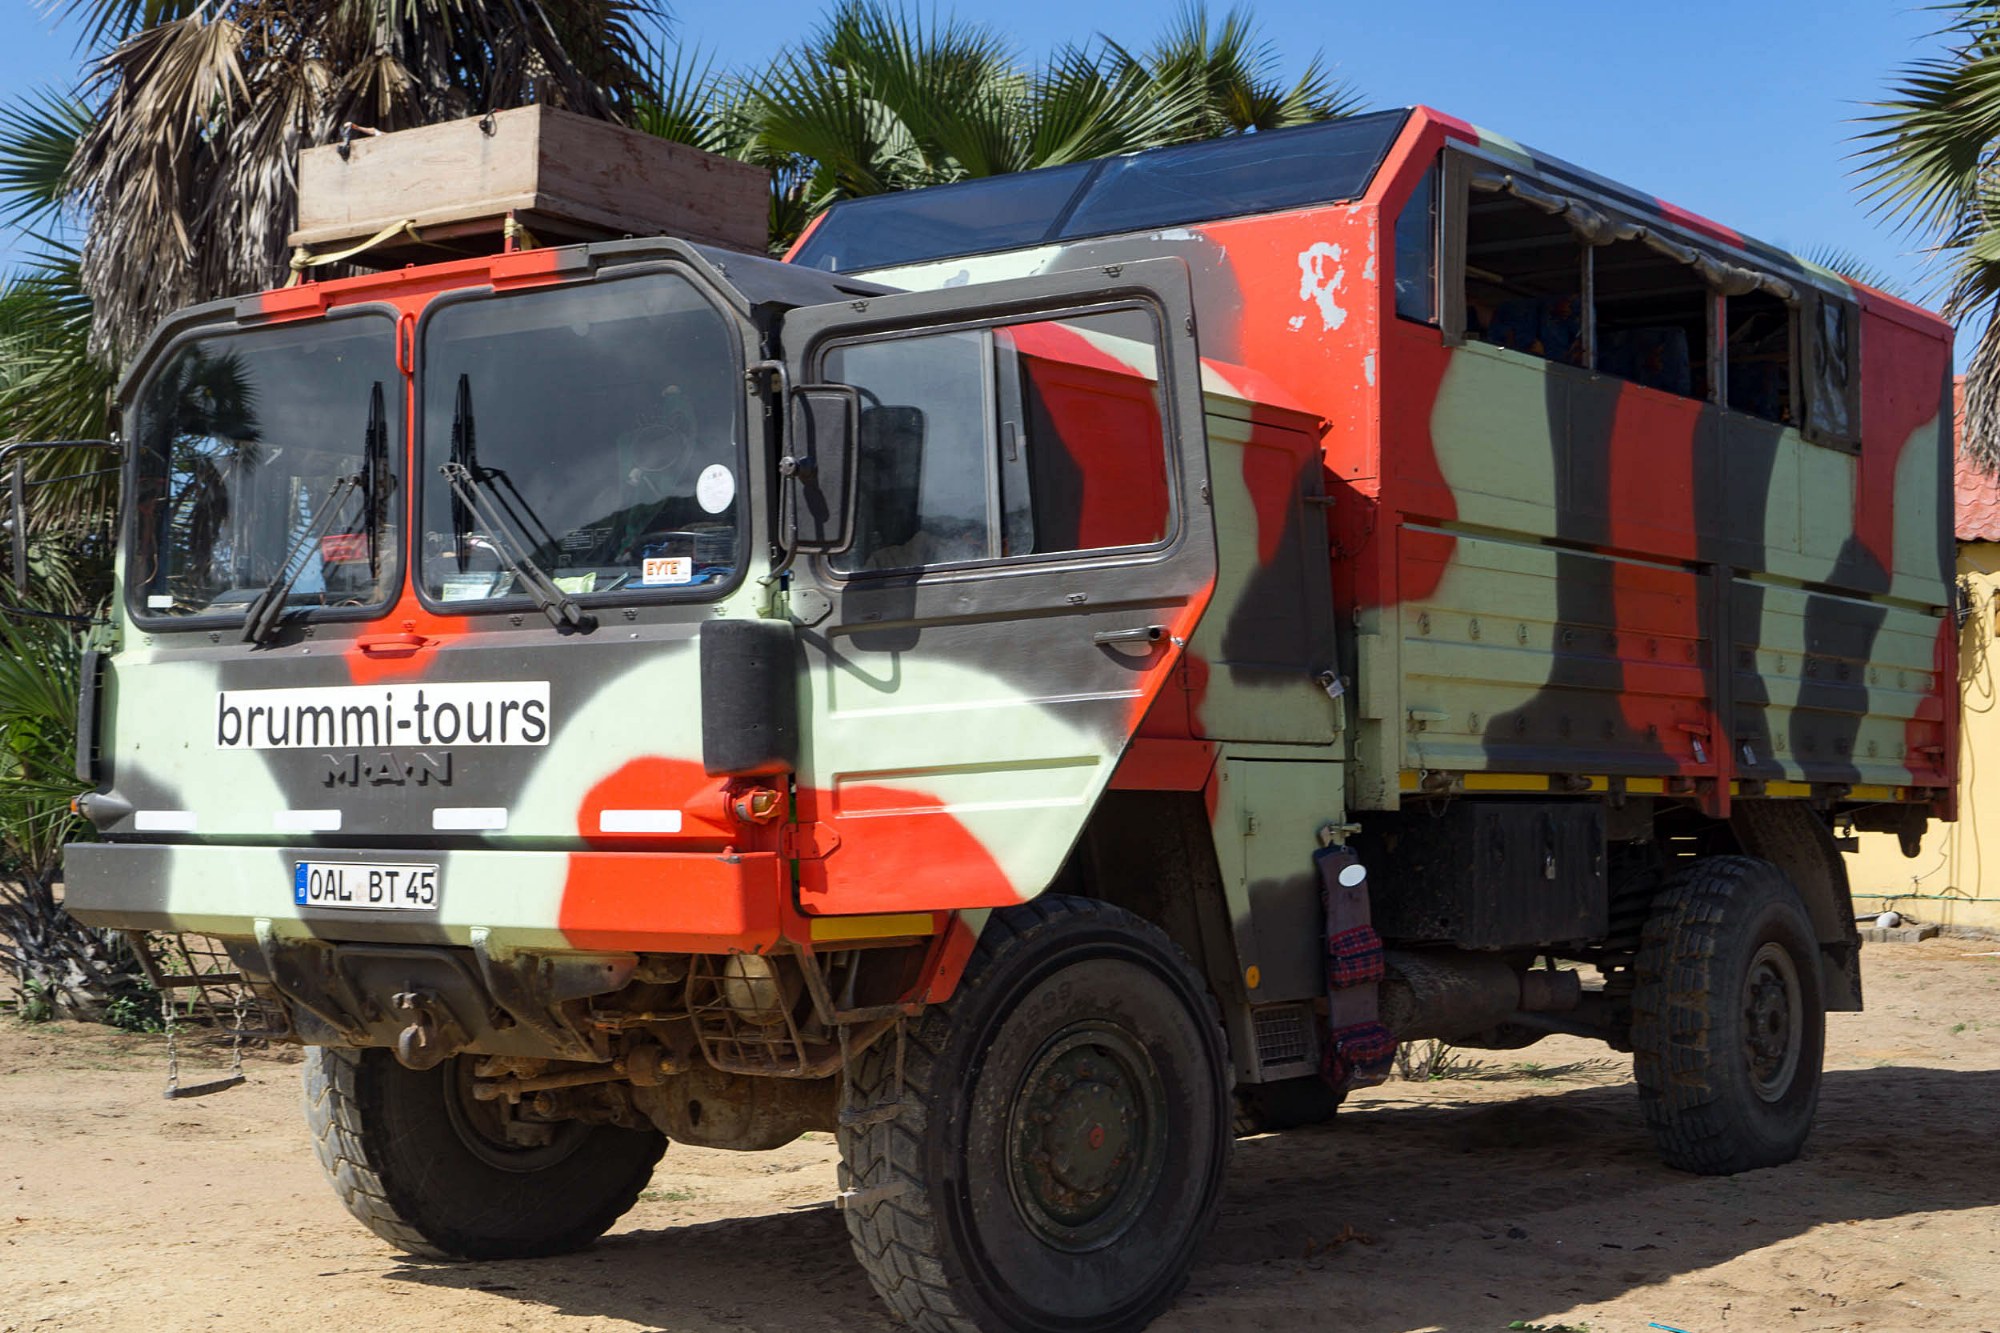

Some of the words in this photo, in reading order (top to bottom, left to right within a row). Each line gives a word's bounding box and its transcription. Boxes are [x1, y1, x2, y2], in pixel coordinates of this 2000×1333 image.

[218, 690, 546, 746] brummi-tours
[310, 869, 352, 901] OAL
[369, 870, 399, 902] BT
[406, 871, 434, 904] 45
